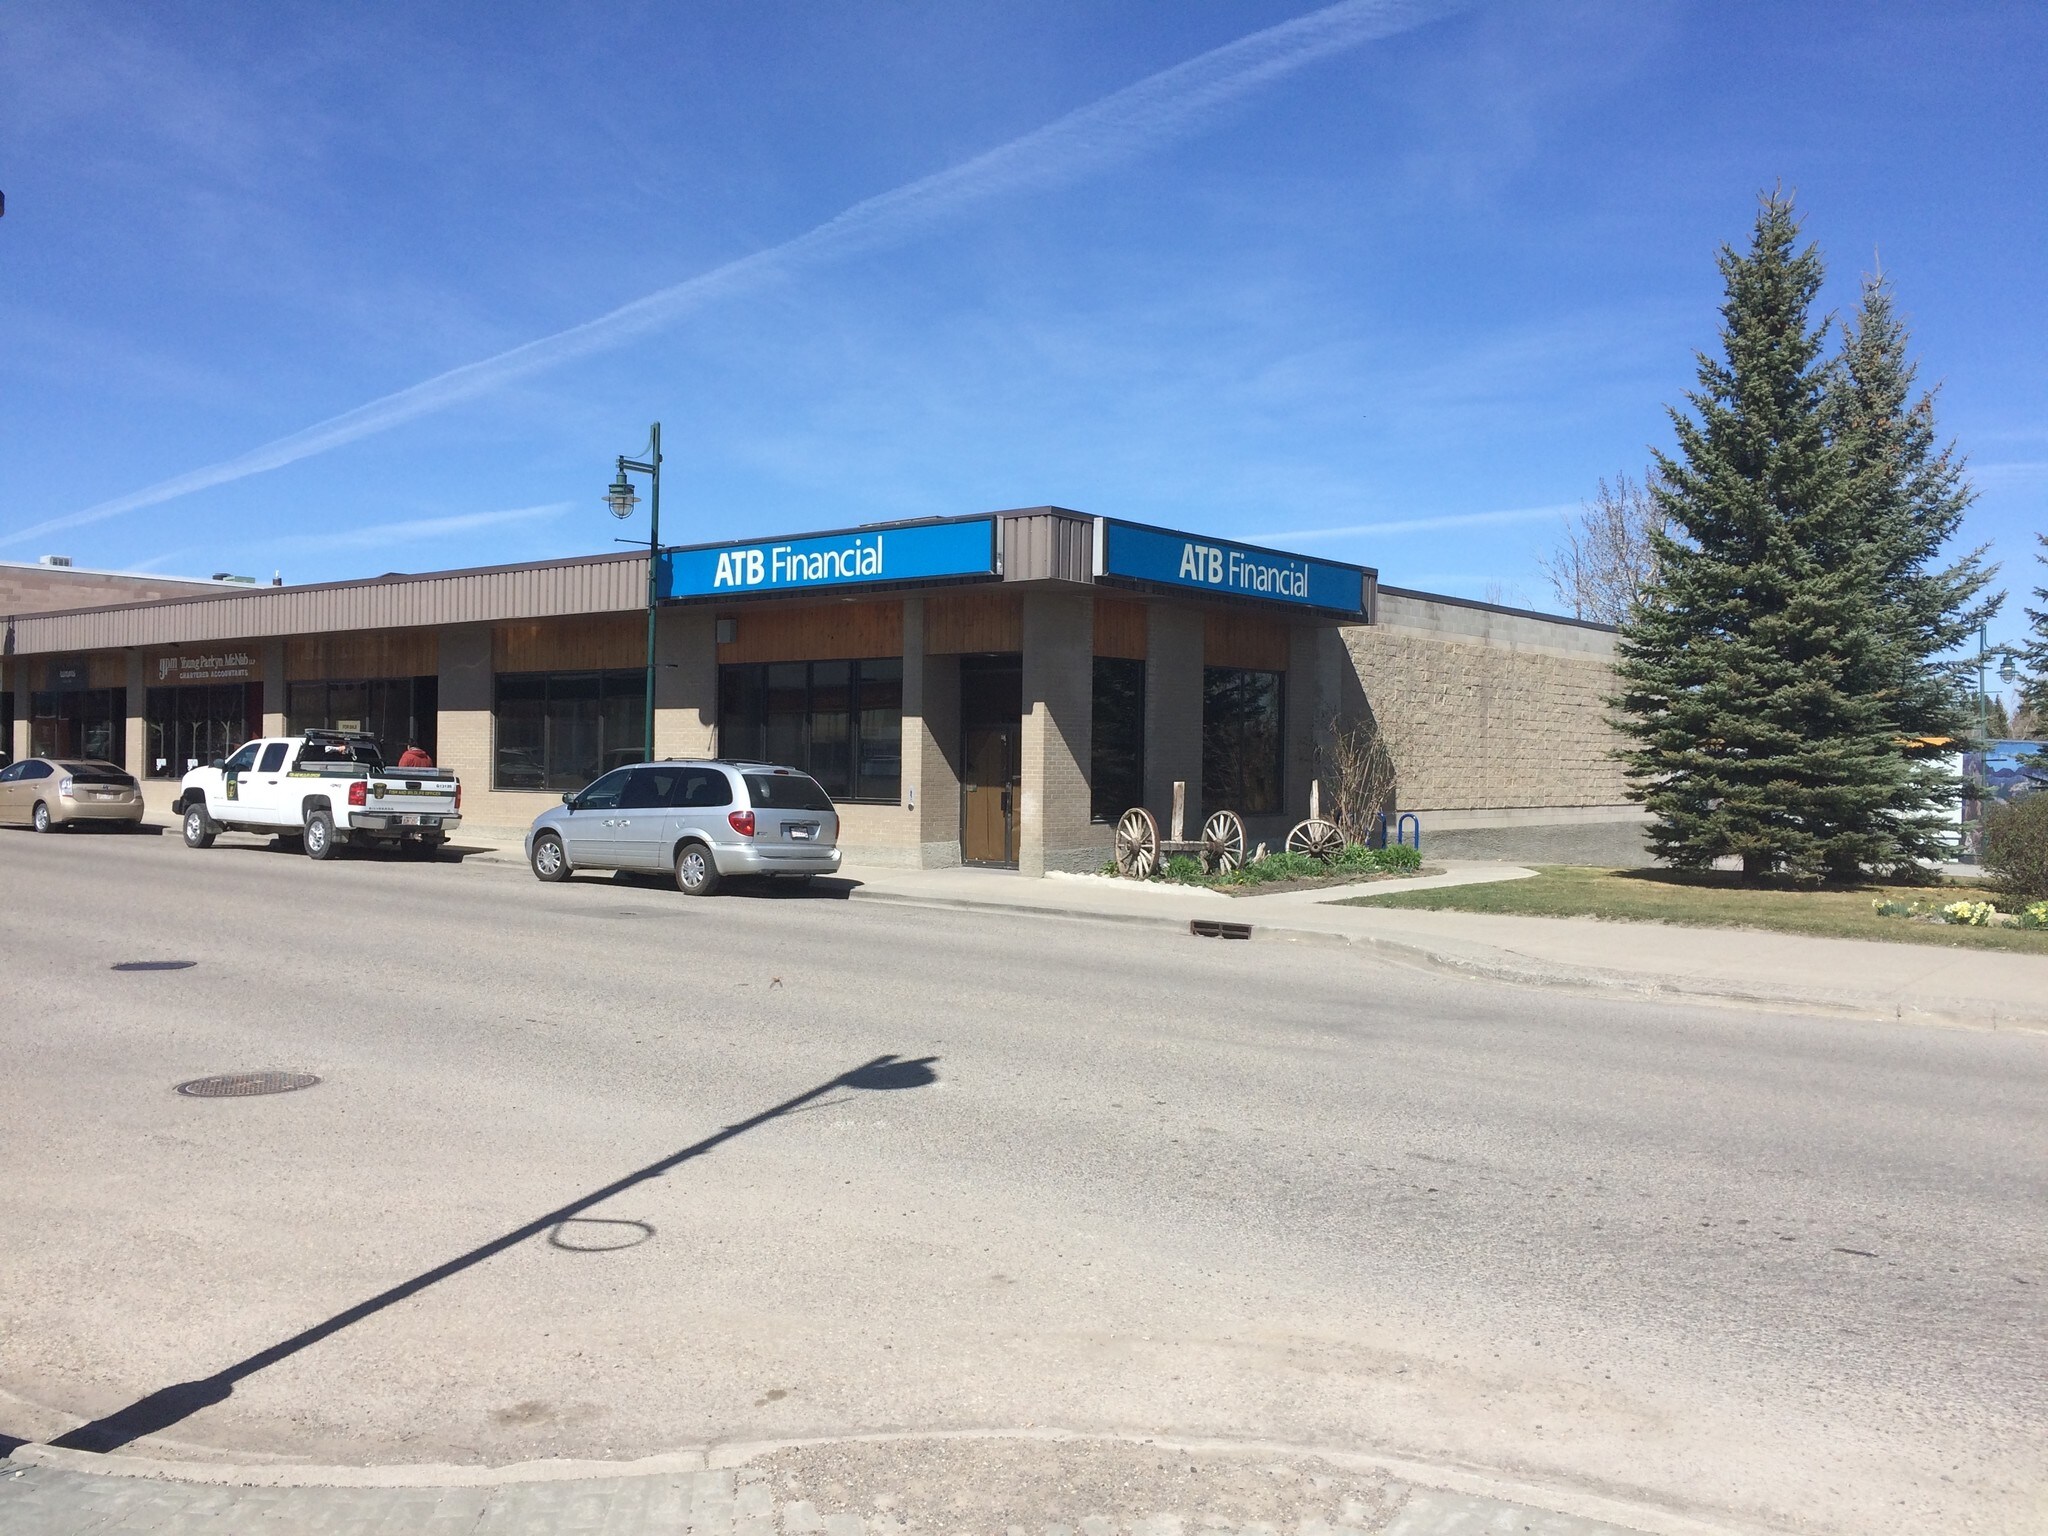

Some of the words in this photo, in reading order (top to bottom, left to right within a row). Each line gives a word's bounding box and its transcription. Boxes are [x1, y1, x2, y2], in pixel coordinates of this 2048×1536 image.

[713, 549, 765, 588] ATB
[772, 535, 883, 583] Financial
[1179, 543, 1223, 584] ATB
[1228, 552, 1309, 598] Financial
[180, 656, 200, 670] Young
[200, 655, 223, 669] Parkyn
[224, 653, 248, 666] McNab
[180, 671, 209, 679] CHARTERED
[211, 669, 248, 678] ACCOUNTANTS
